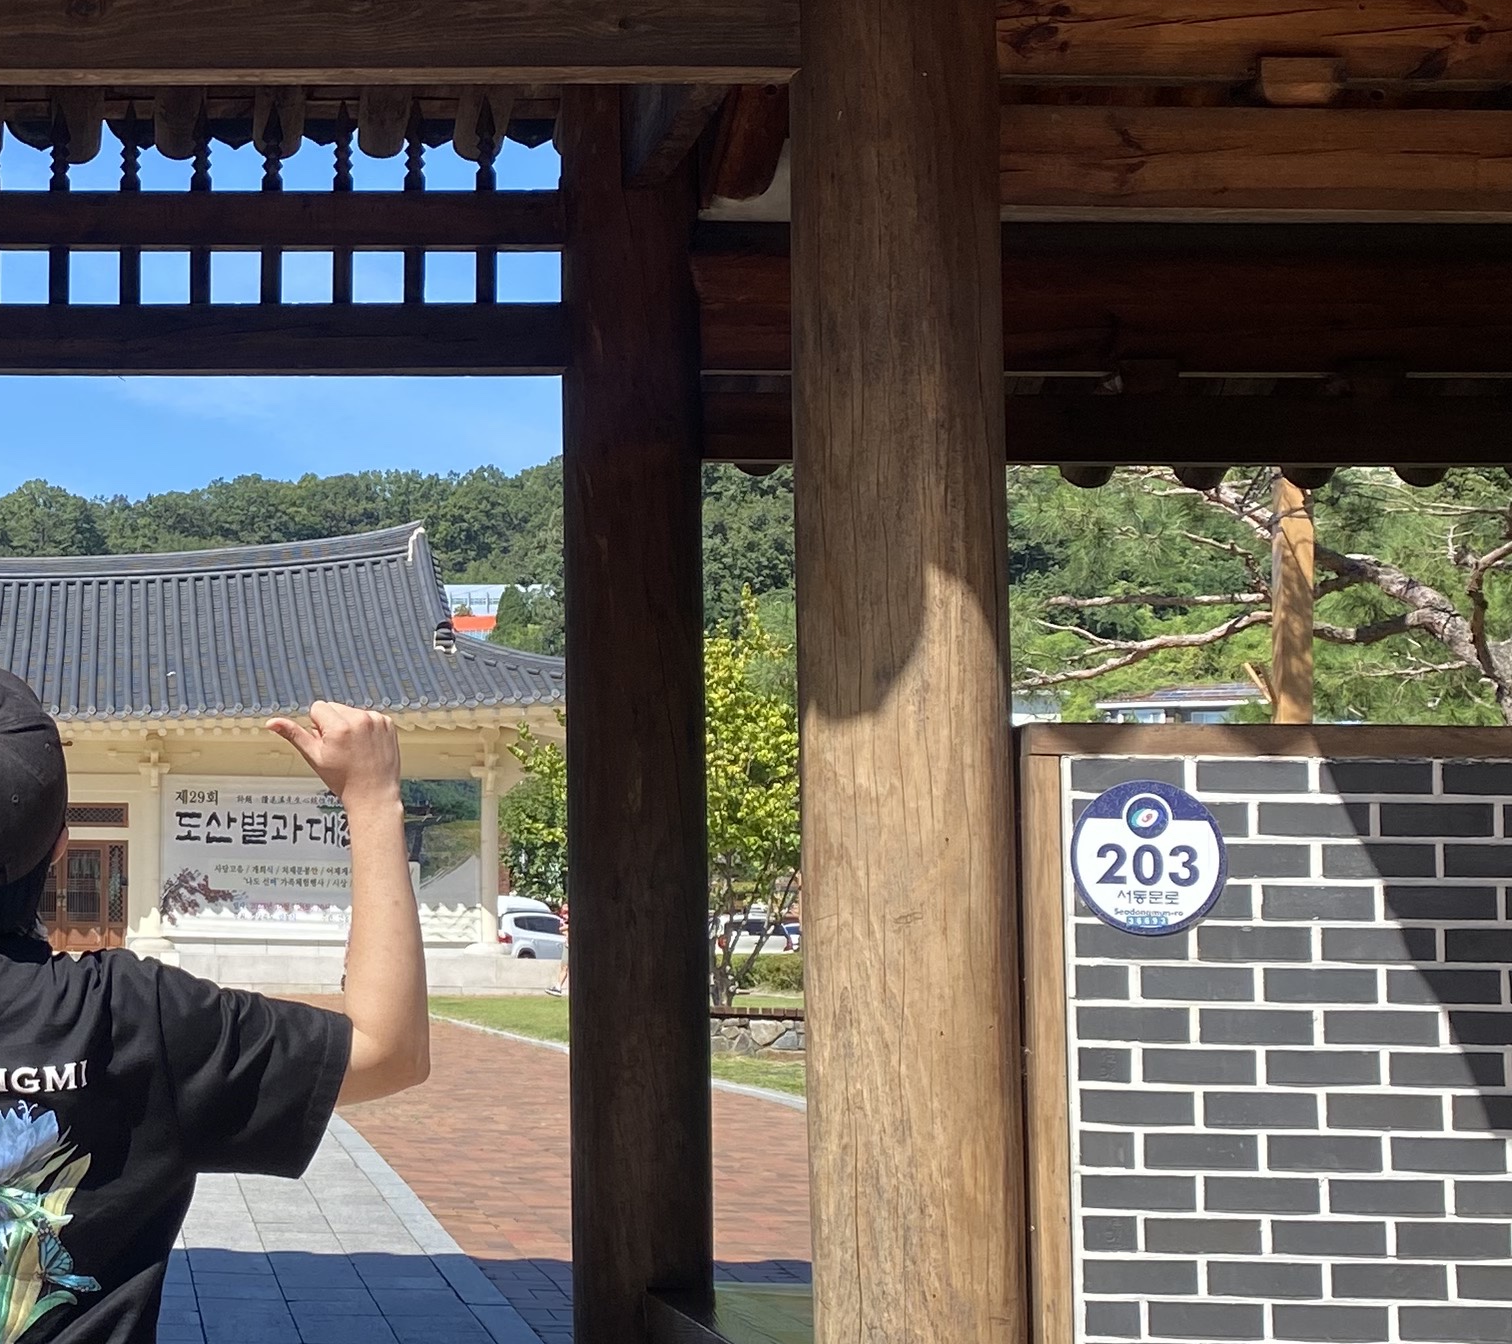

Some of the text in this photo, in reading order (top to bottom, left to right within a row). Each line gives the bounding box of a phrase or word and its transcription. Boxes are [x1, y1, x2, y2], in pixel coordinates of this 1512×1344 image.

[175, 790, 219, 806] 제29회
[1096, 843, 1200, 887] 203
[1117, 890, 1180, 905] 서동문로
[1114, 908, 1184, 917] Seodongmun-ro
